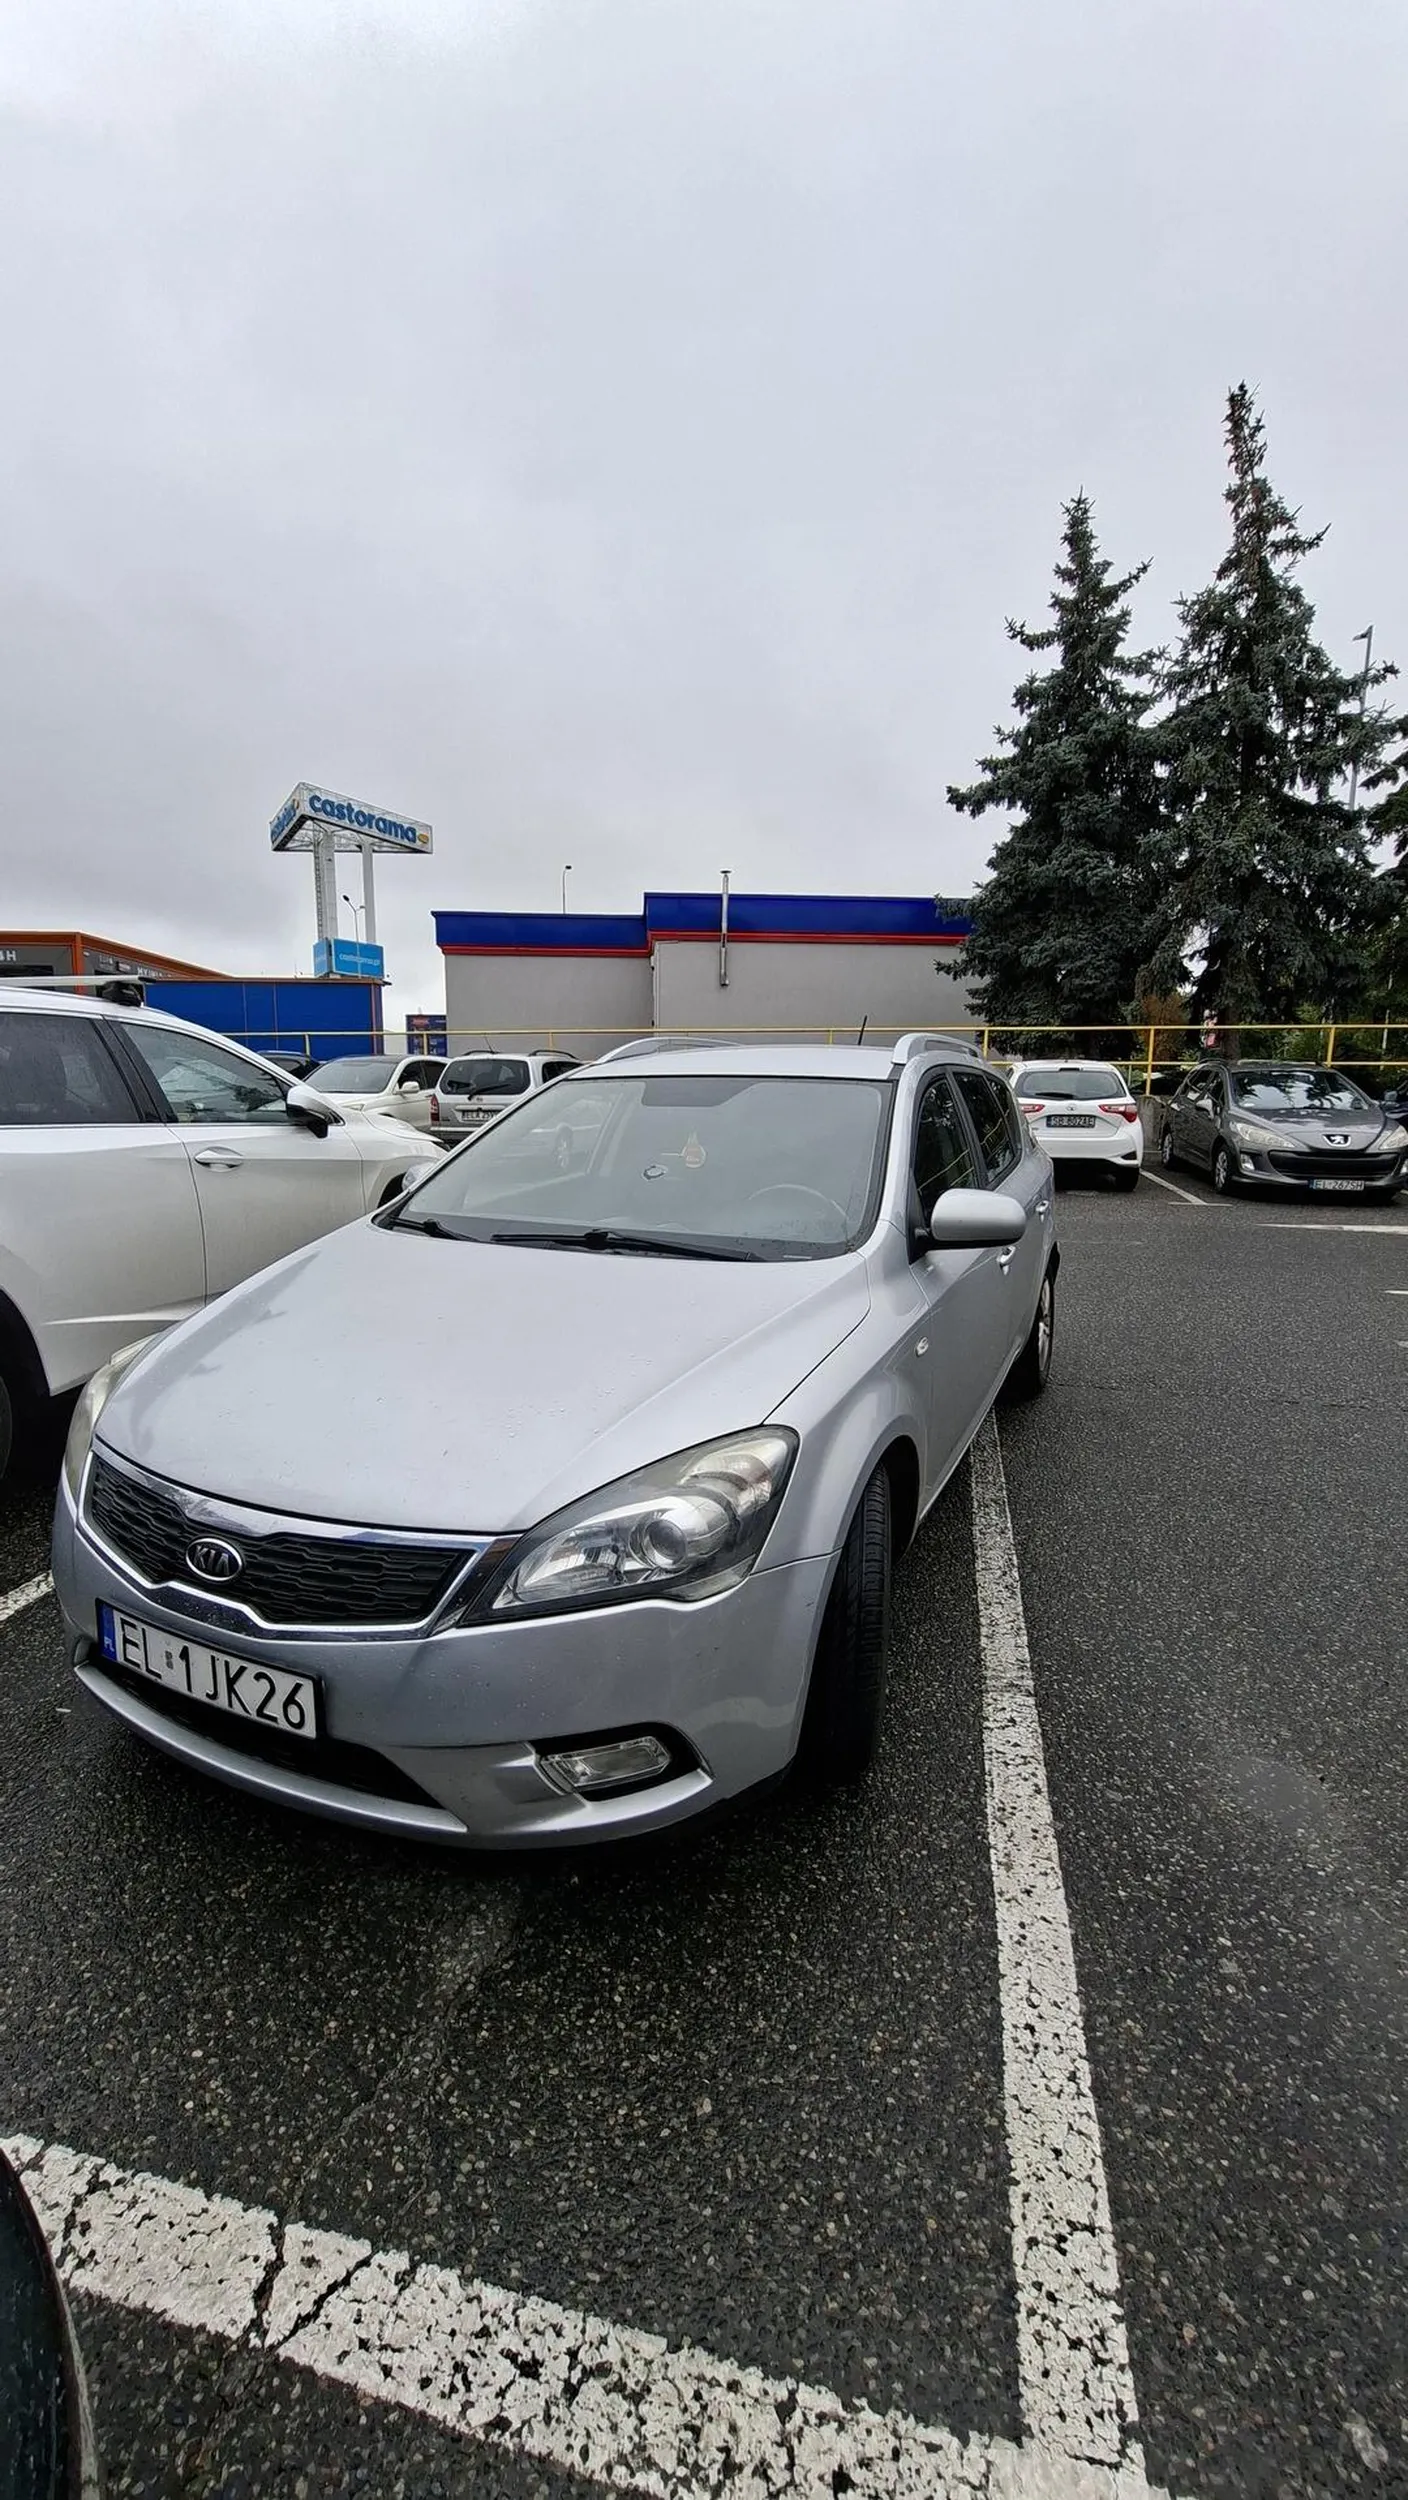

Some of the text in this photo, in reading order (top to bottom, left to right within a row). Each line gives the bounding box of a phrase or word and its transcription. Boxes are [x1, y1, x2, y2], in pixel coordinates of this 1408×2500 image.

[308, 794, 417, 844] castorama
[193, 1545, 230, 1576] KIA
[120, 1617, 306, 1730] EL 1JK26
